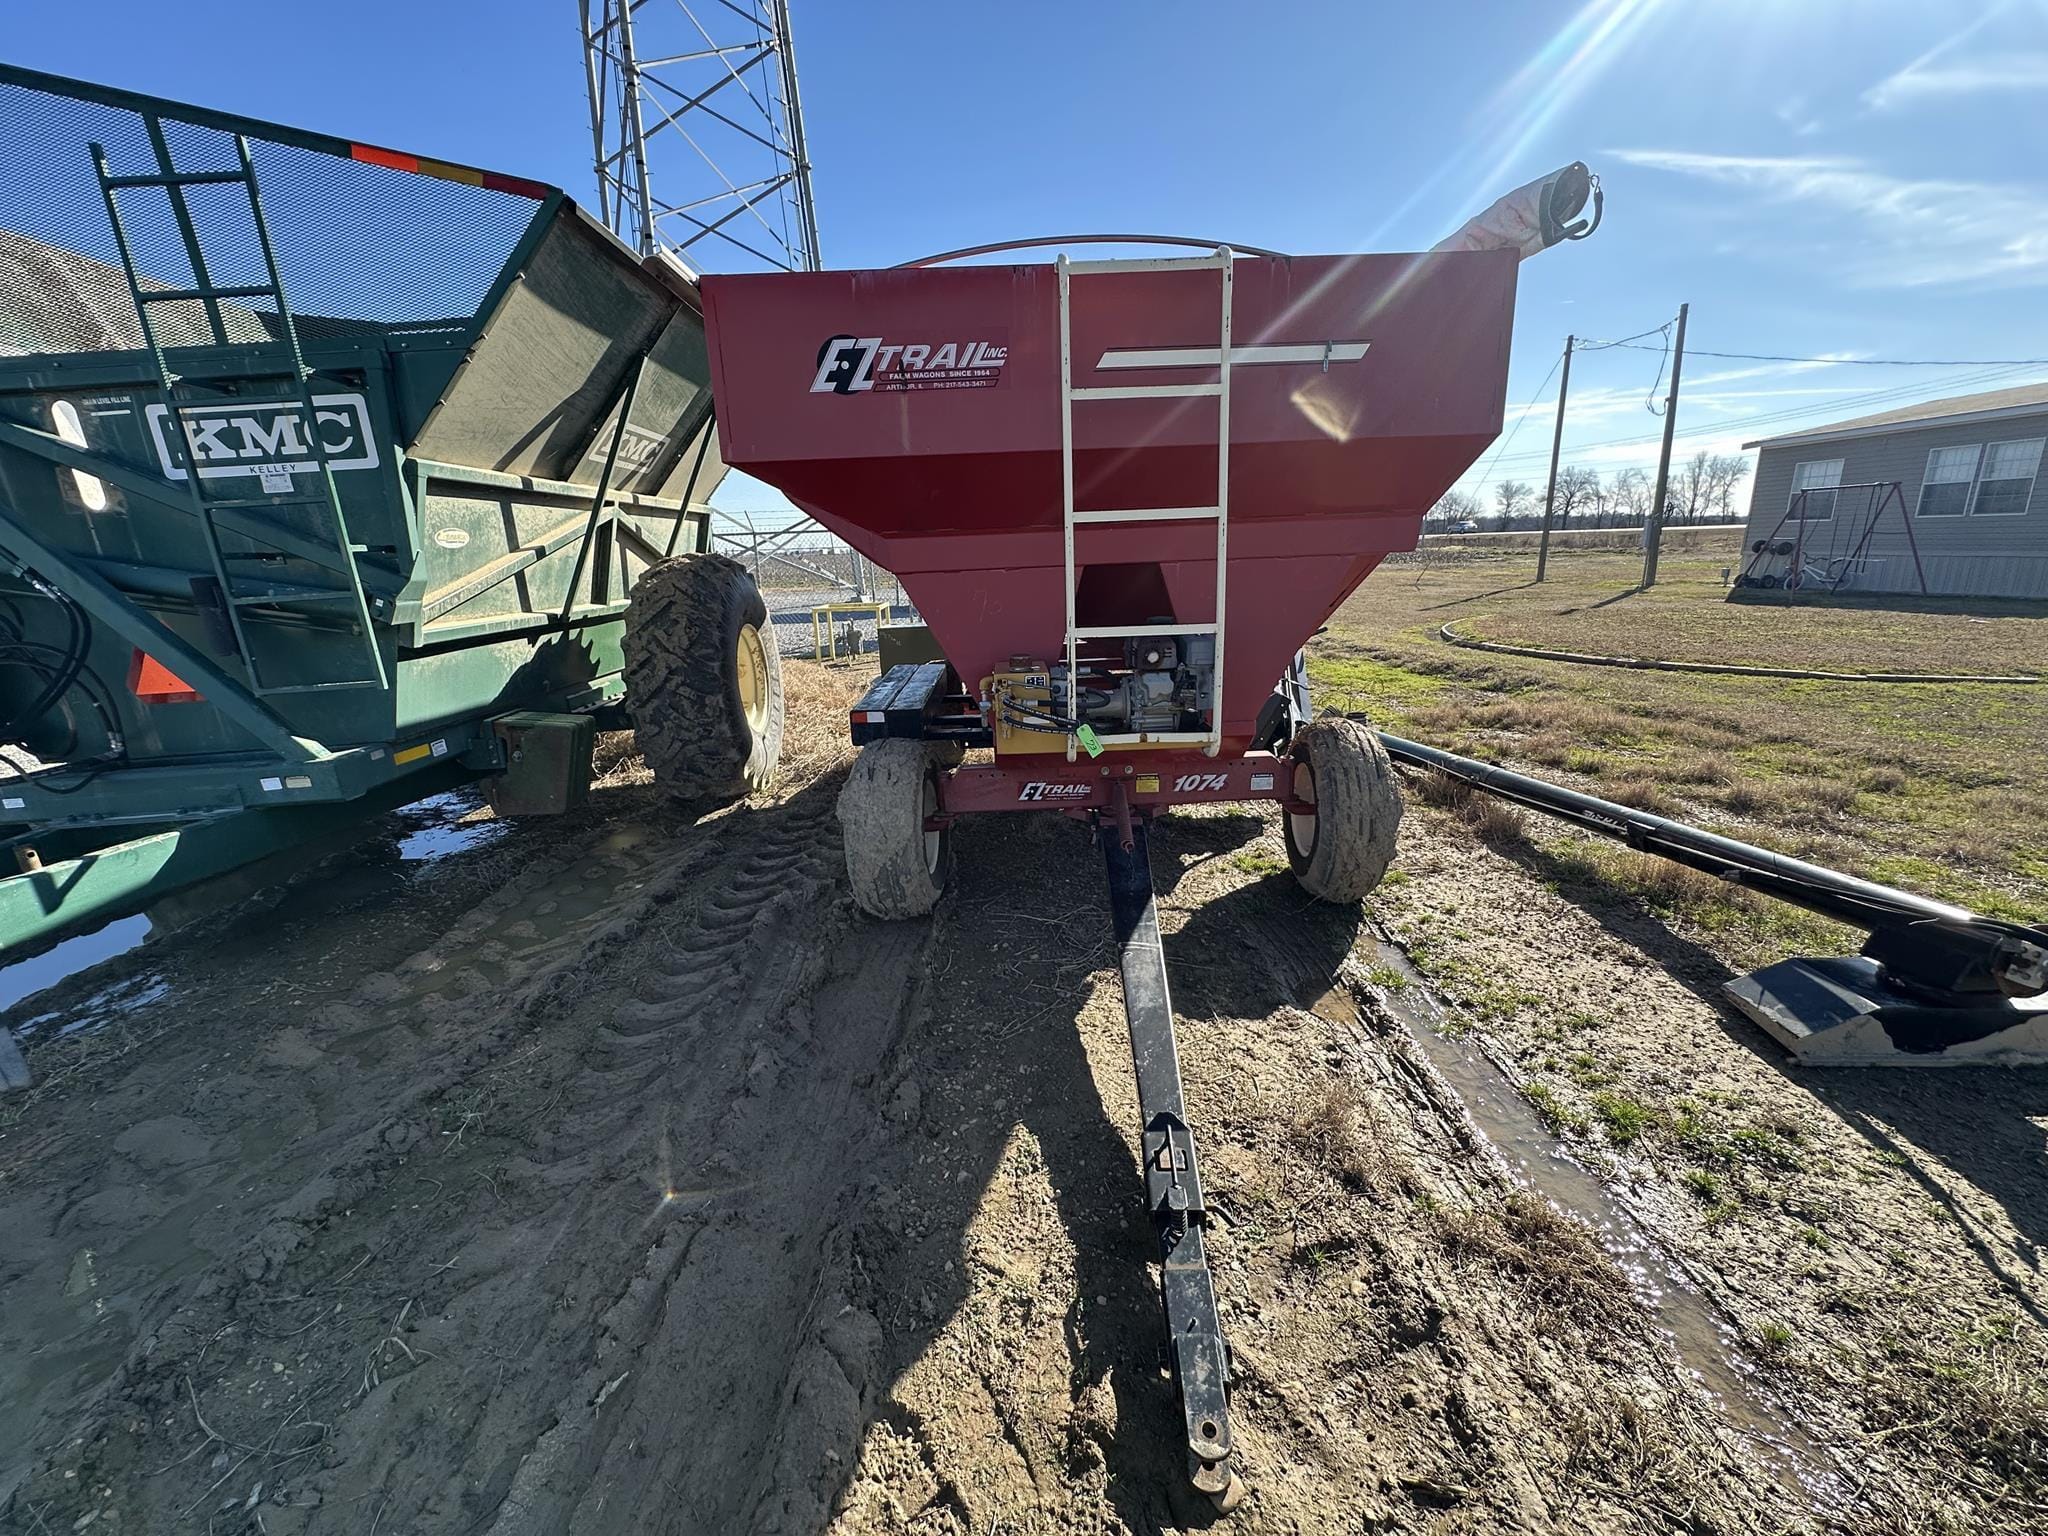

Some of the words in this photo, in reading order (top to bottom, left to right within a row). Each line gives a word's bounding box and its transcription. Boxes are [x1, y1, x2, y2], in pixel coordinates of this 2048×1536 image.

[877, 342, 1006, 371] TRAIL
[984, 347, 1008, 358] INC.
[912, 371, 946, 379] WAGONS
[169, 411, 354, 460] KMC
[250, 463, 297, 474] KELLEY
[1043, 784, 1091, 794] TRAIL
[1173, 773, 1228, 792] 1074
